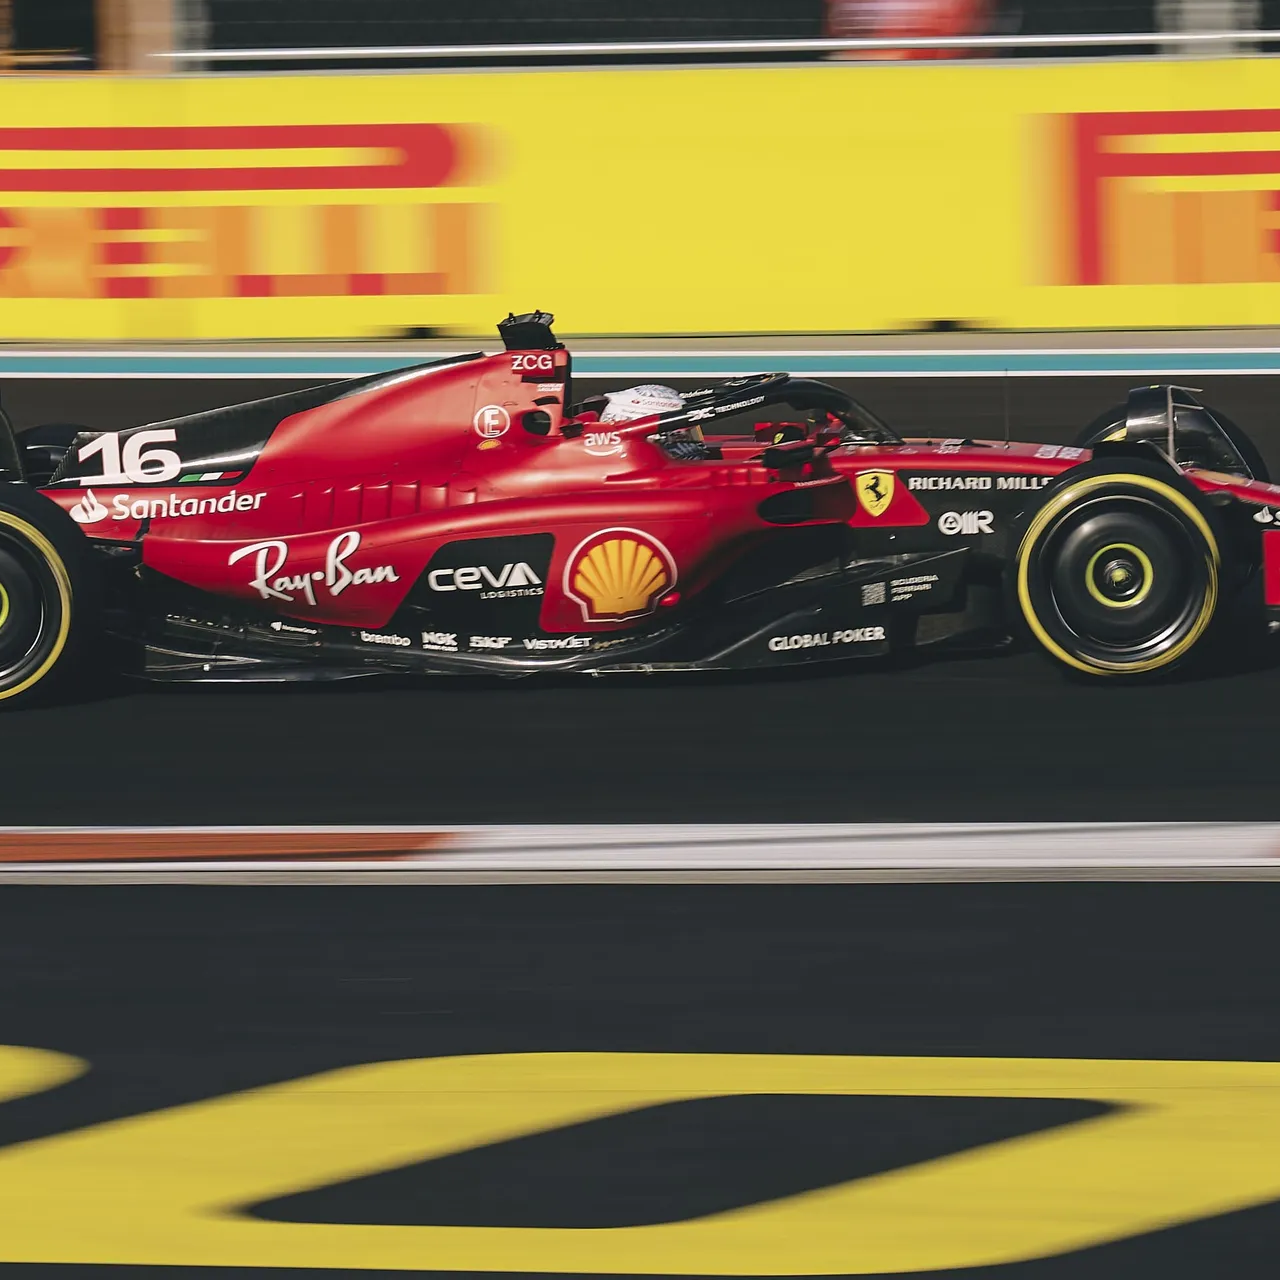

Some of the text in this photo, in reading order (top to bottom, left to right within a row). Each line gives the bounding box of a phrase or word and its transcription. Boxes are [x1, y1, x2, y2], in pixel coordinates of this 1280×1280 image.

[511, 355, 553, 370] ZCG
[583, 431, 621, 447] aws
[78, 428, 181, 486] 16
[908, 477, 992, 490] RICHARD
[111, 490, 267, 521] Santander
[480, 587, 544, 600] LOGISTICS
[360, 630, 411, 647] brembo
[421, 631, 458, 646] NGK
[469, 635, 513, 649] SKF
[768, 626, 886, 652] GLOBAL POKER
